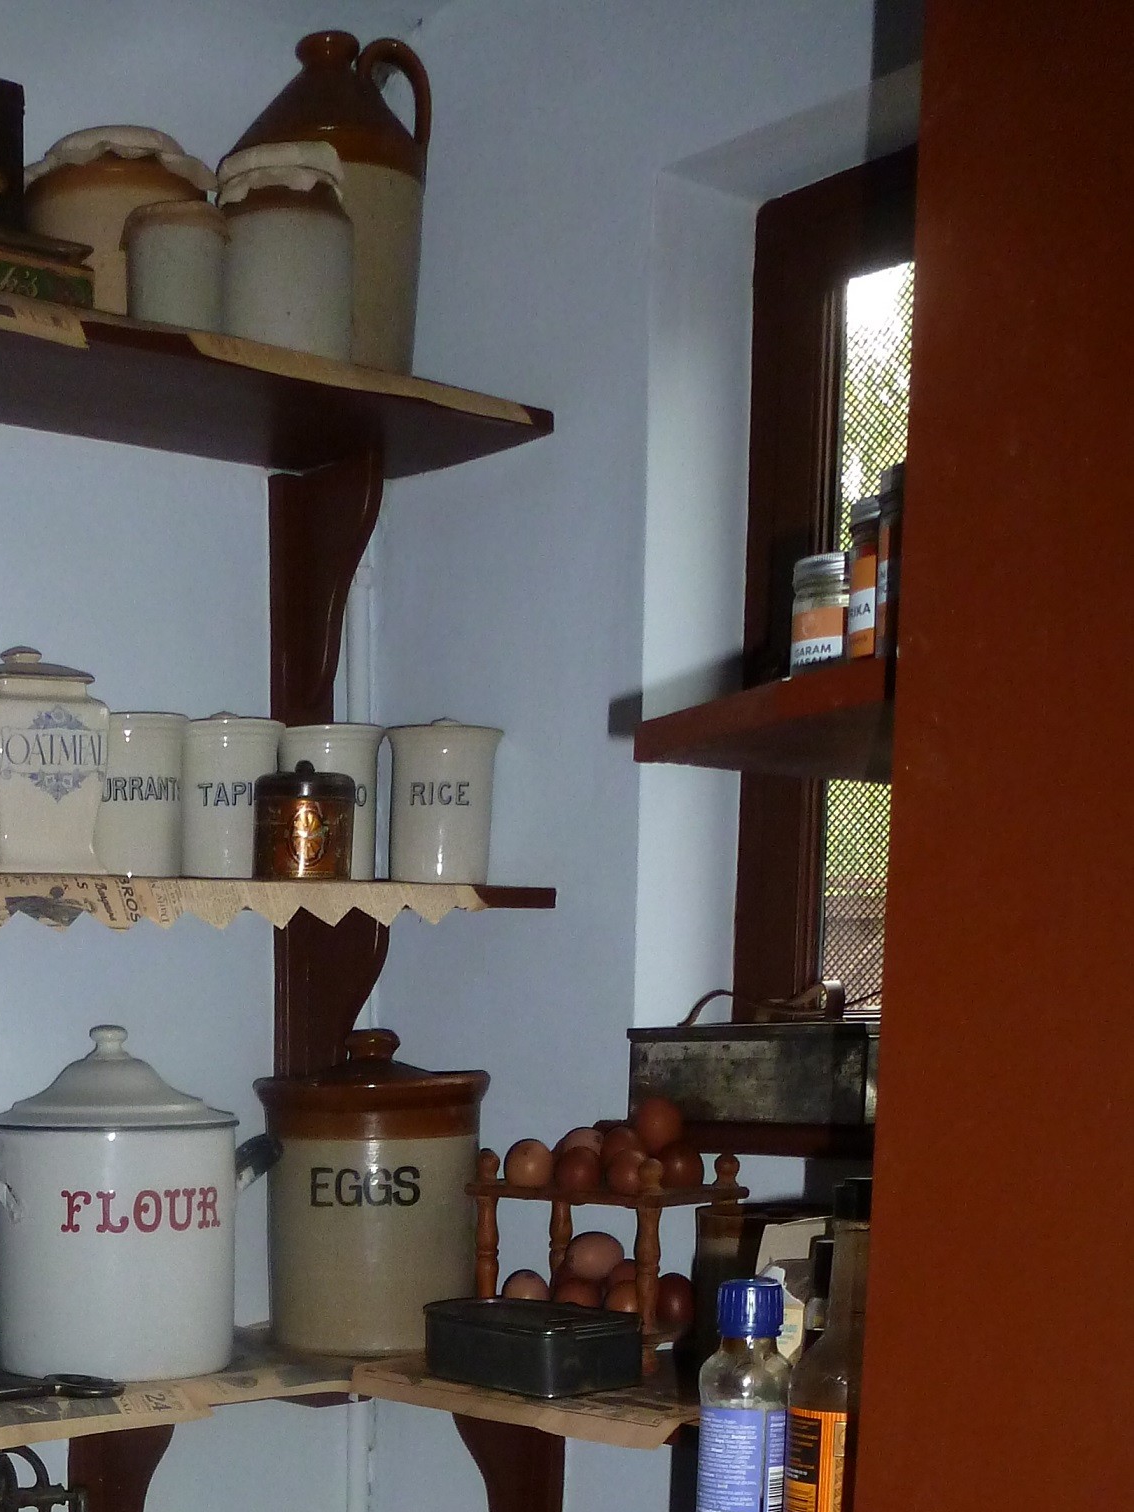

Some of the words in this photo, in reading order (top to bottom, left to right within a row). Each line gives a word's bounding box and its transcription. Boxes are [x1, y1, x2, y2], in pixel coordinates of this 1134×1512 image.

[849, 602, 871, 618] RIKA
[795, 644, 832, 657] GARAM
[5, 733, 108, 766] OATMEAL
[102, 777, 183, 802] URRANT
[198, 782, 254, 807] TAPI
[410, 781, 471, 806] RICE
[310, 1166, 421, 1208] EGGS
[60, 1186, 222, 1235] FLOUR
